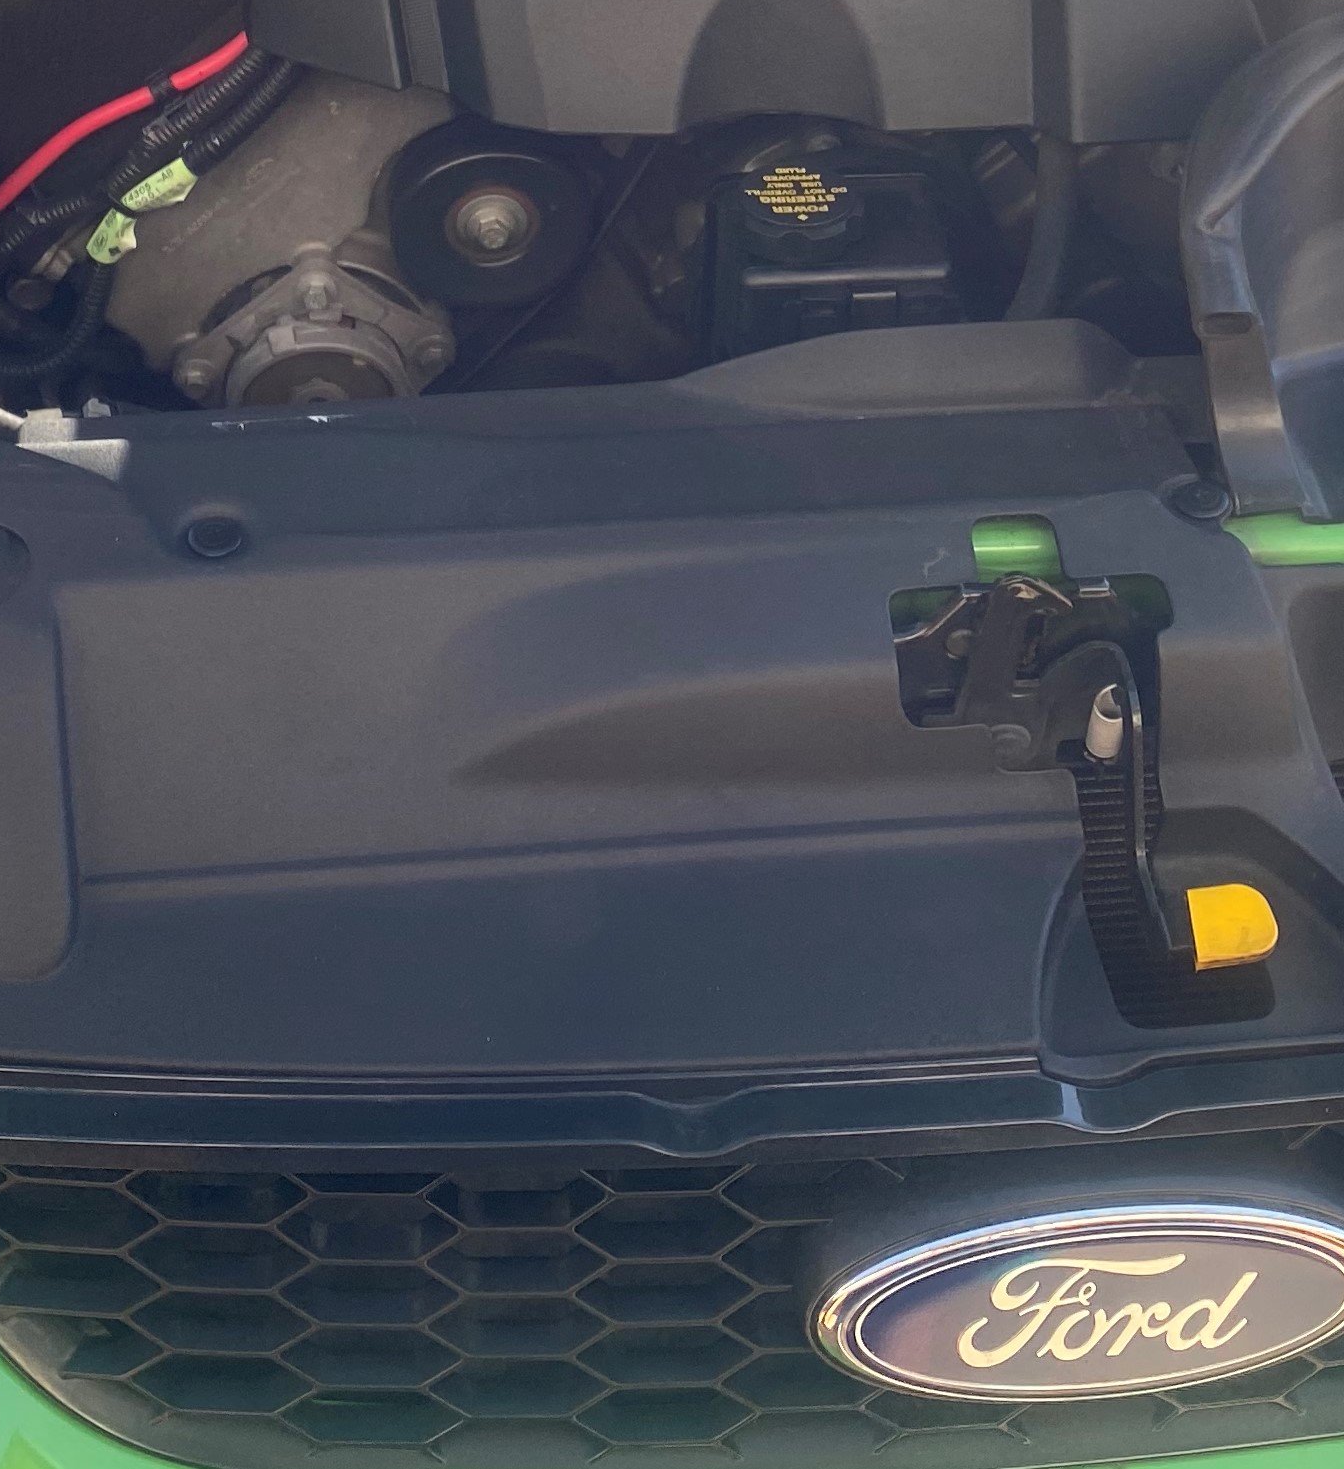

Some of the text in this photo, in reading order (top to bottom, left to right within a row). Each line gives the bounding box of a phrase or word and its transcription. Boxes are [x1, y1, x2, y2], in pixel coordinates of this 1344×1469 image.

[744, 188, 797, 196] OVERFILL
[759, 194, 835, 204] STEERING
[772, 204, 829, 214] POWER
[956, 1253, 1257, 1369] Ford
